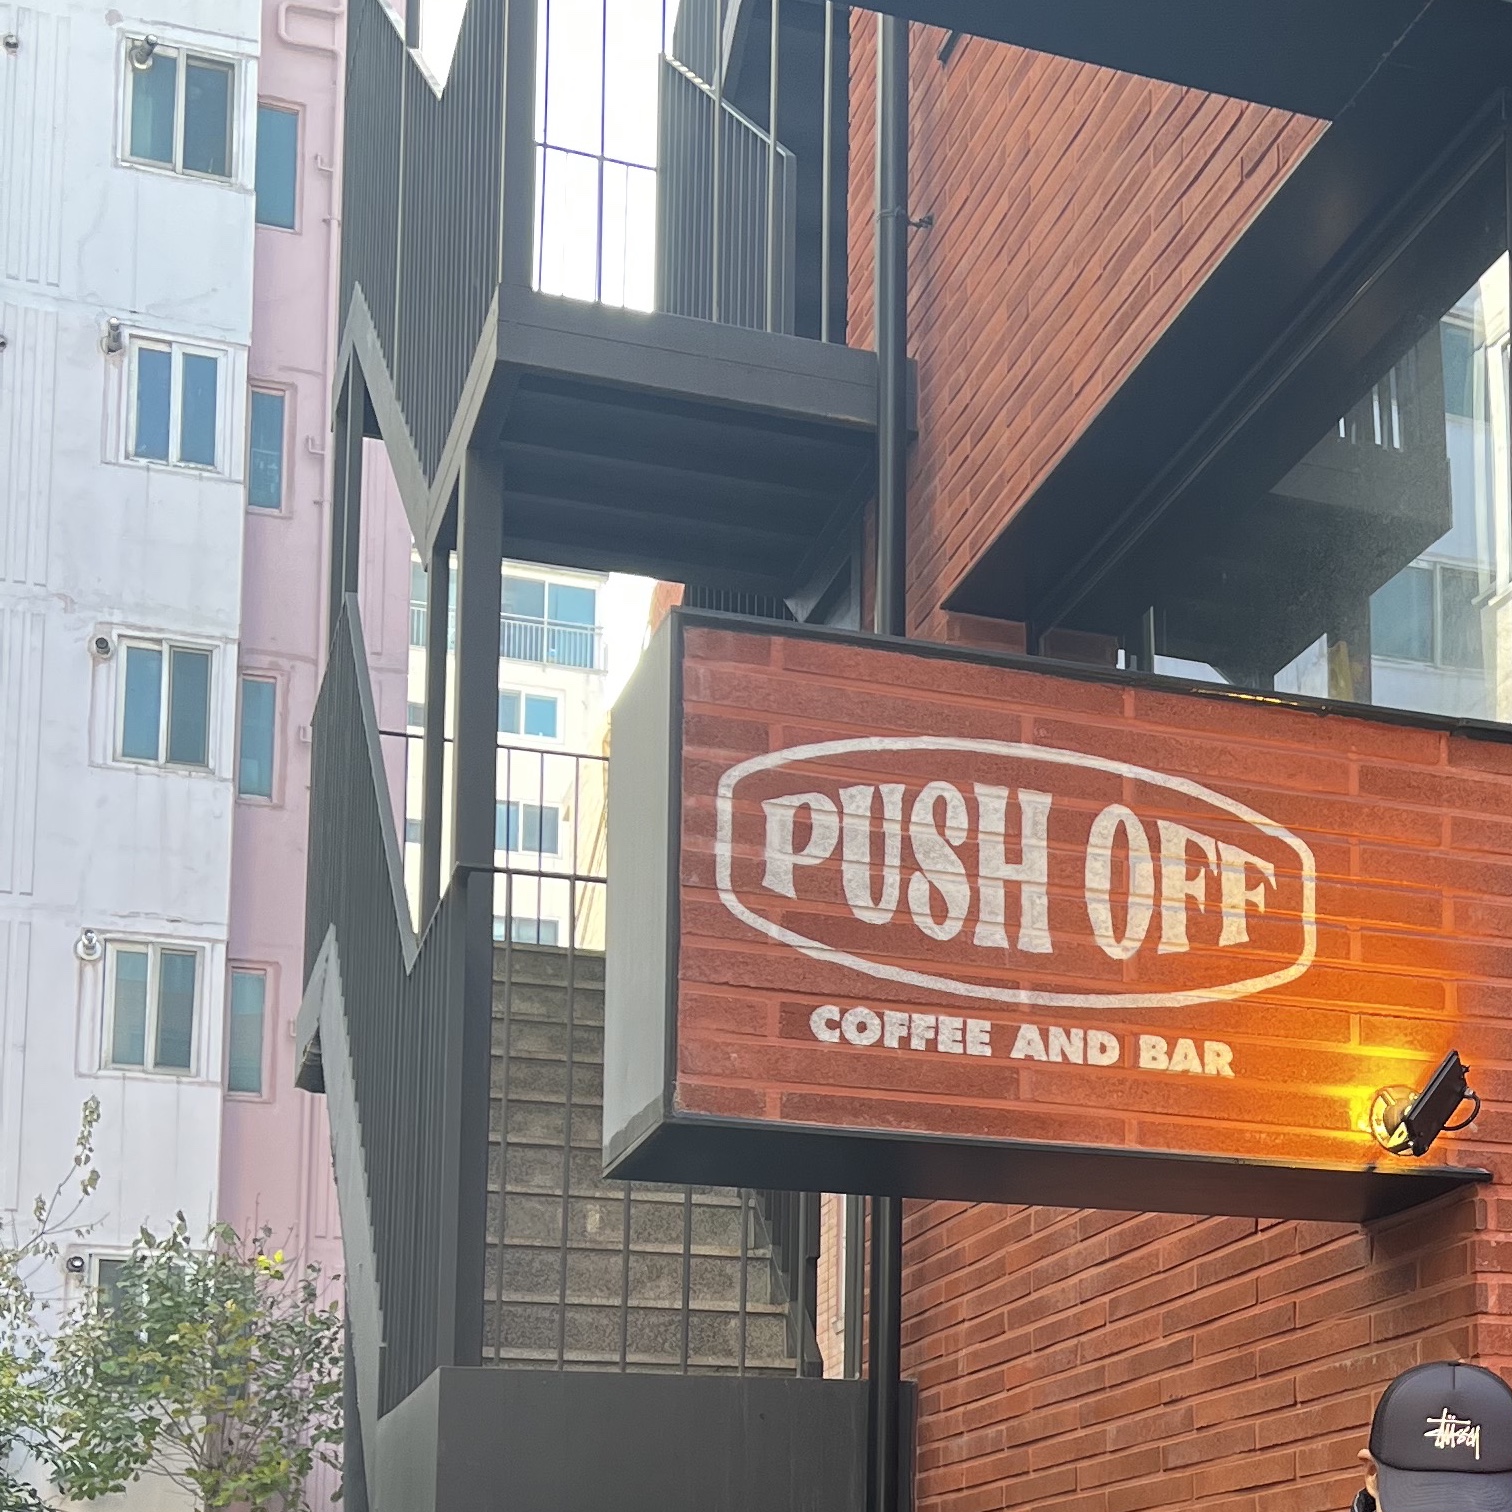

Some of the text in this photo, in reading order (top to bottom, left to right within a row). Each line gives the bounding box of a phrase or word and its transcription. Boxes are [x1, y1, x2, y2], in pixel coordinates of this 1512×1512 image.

[760, 780, 1278, 961] PUSH OFF
[809, 1004, 1236, 1078] COFFEE AND BAR
